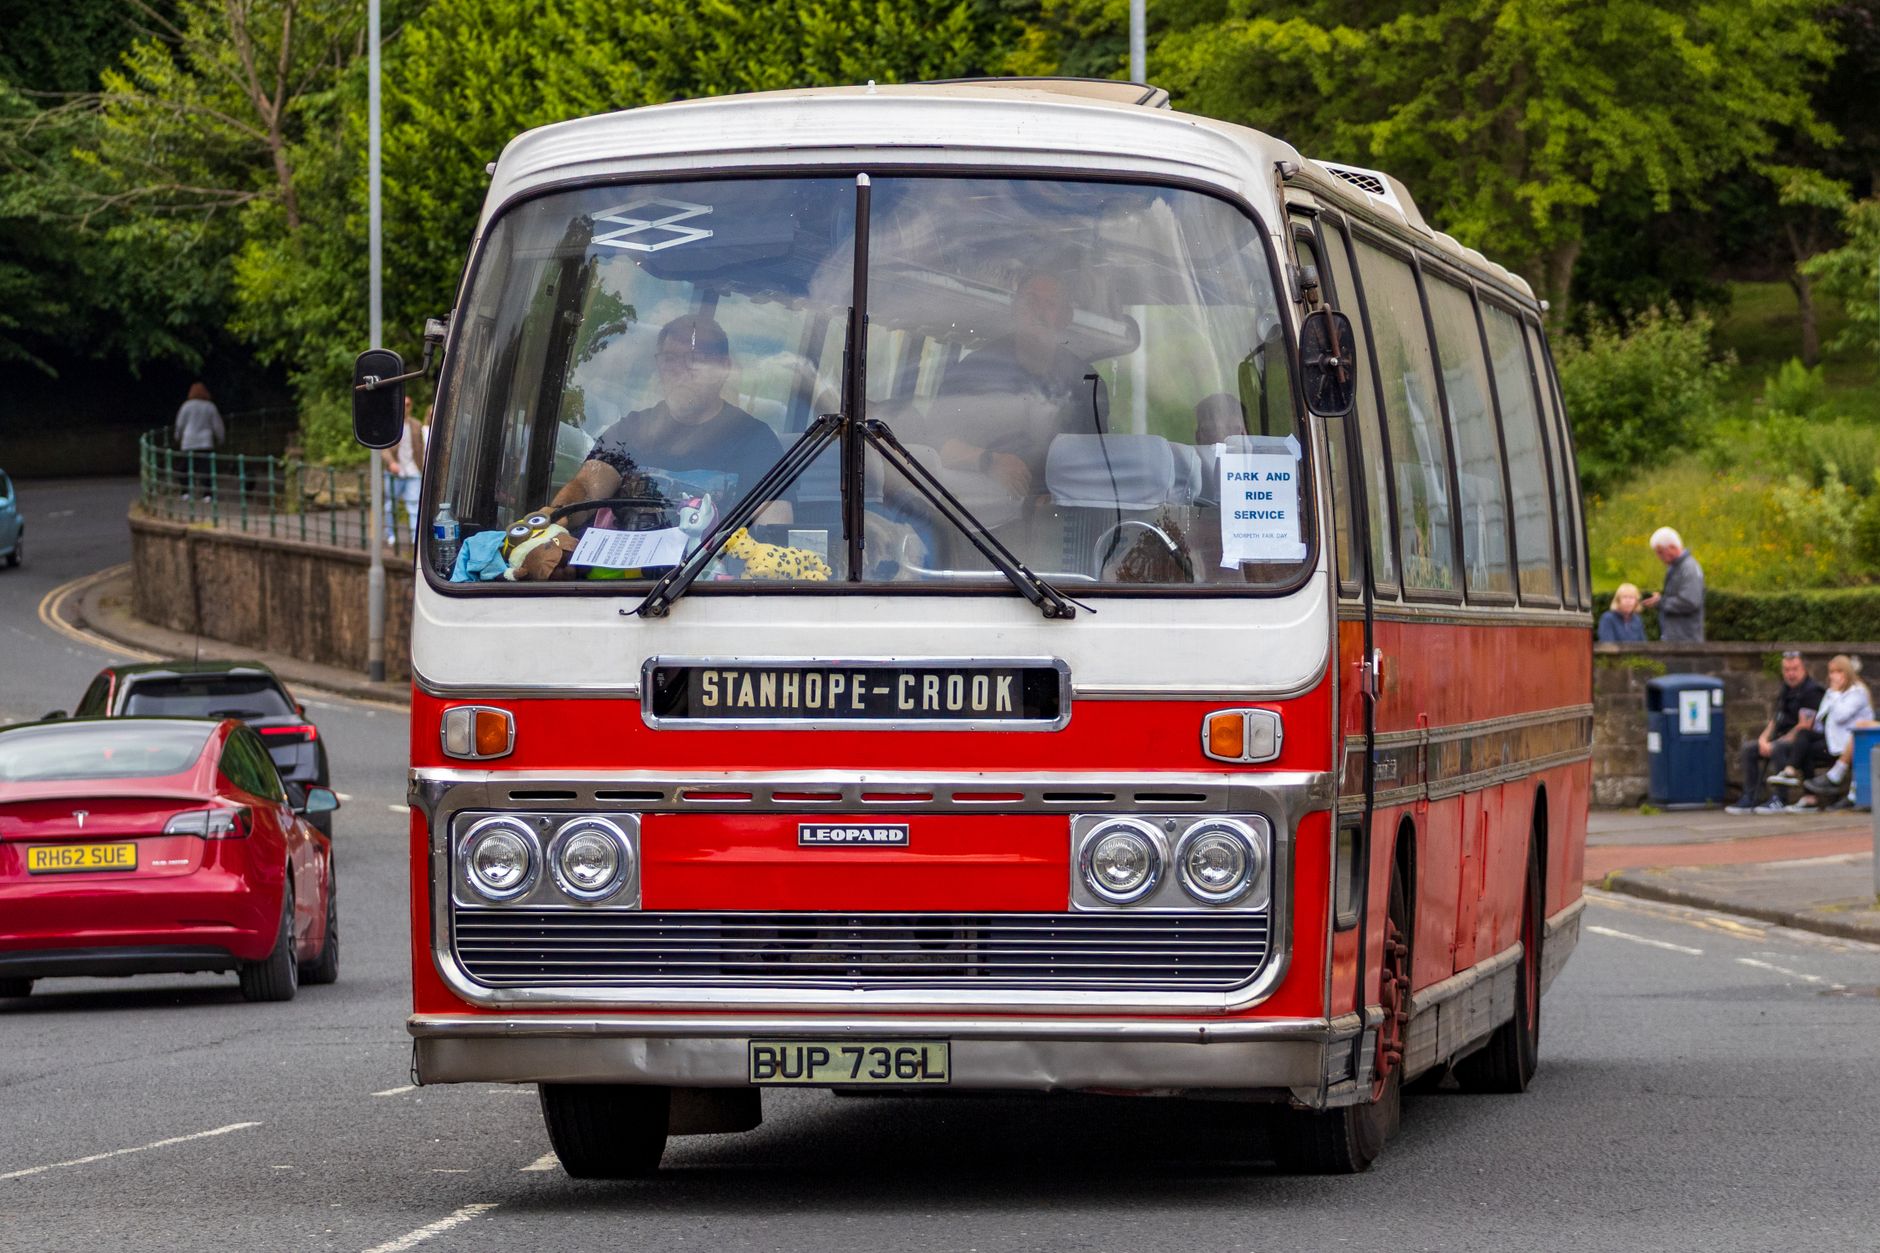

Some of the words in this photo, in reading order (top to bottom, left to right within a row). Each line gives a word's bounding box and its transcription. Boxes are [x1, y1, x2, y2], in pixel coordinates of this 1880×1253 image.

[1227, 472, 1260, 481] PARK
[1266, 472, 1291, 481] AND
[1245, 491, 1273, 500] RIDE
[1234, 510, 1285, 520] SERVICE
[802, 829, 904, 841] LEOPARD
[36, 848, 85, 867] RH62
[91, 846, 128, 865] SUE
[753, 1046, 830, 1079] BUP
[841, 1046, 945, 1079] 736L
